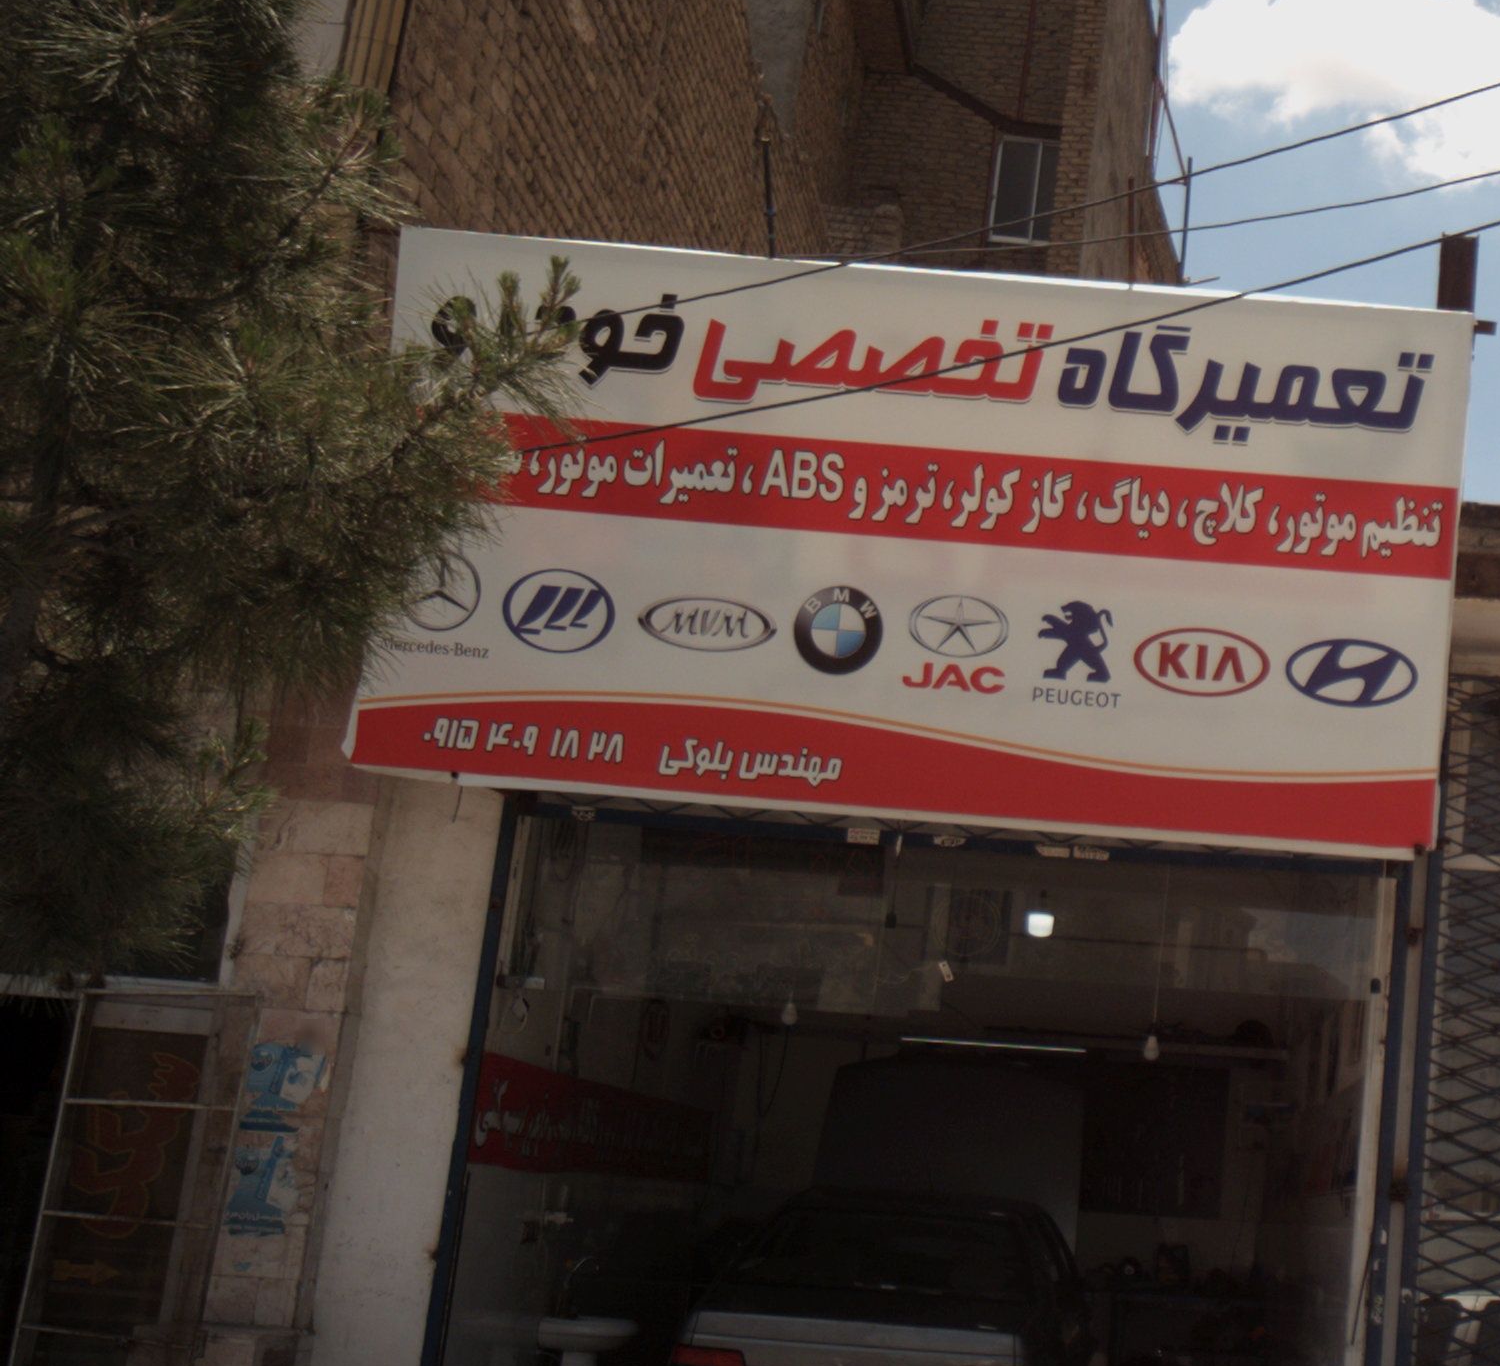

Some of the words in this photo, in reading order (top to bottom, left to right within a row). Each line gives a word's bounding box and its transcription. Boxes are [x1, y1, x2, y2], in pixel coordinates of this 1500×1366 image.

[692, 319, 1054, 403] تخصصی
[1056, 324, 1435, 445] تعمیرگاه
[623, 439, 738, 505] تعمیرات
[872, 462, 940, 524] ترمز
[847, 476, 867, 521] و
[1020, 469, 1074, 533] گاز
[1361, 496, 1443, 558] تنظیم
[659, 607, 750, 640] MVM
[806, 587, 879, 621] BMW
[901, 662, 1006, 695] JAC
[1158, 641, 1247, 684] KIA
[1031, 686, 1122, 710] PEUGEOT
[549, 727, 581, 760] ۱۸
[658, 738, 735, 780] بلوکی
[738, 747, 843, 787] مهندس
